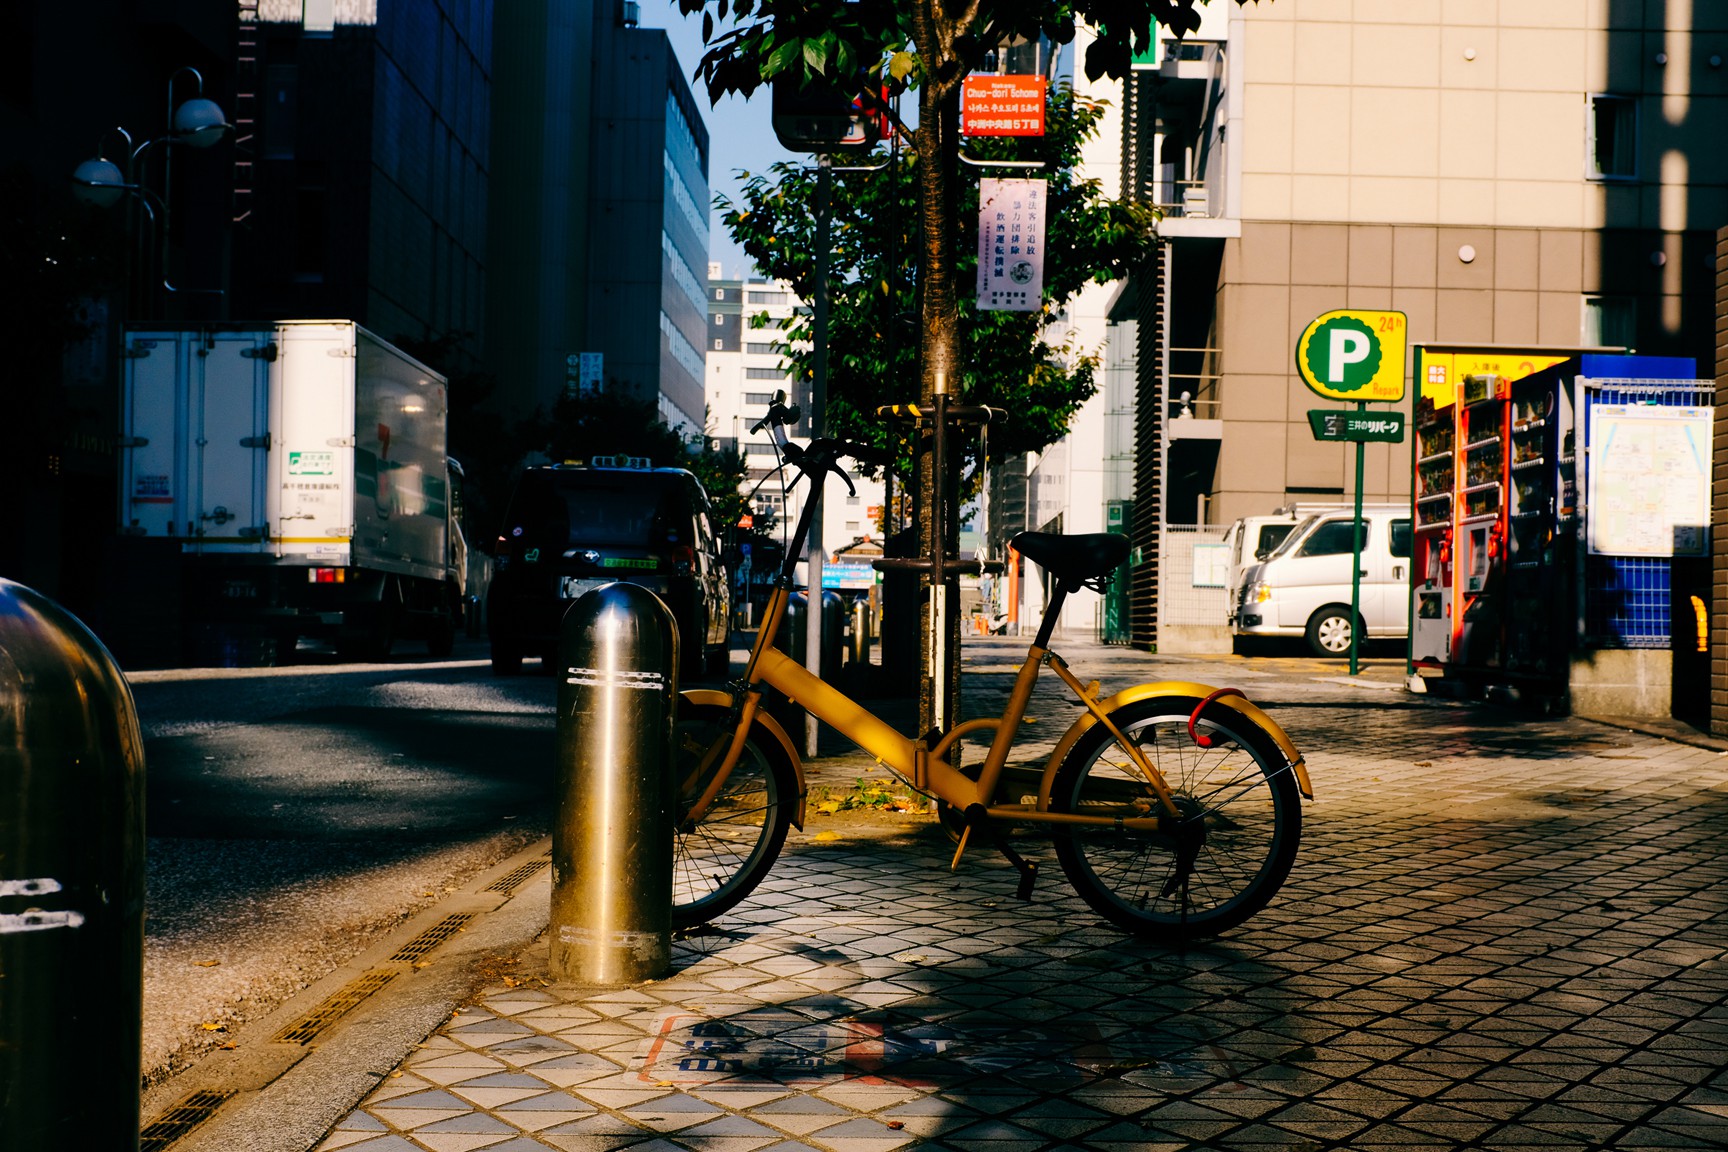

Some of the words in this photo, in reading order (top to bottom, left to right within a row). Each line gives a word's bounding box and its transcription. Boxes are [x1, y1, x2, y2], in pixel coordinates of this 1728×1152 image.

[967, 88, 1008, 98] Chuo-dori
[994, 211, 1006, 278] 飲酒運転撲滅
[1010, 200, 1022, 255] 暴力団排除
[1026, 189, 1038, 255] 違法客引追放
[1328, 328, 1371, 382] P
[1372, 382, 1400, 396] Repark
[1347, 419, 1399, 434] 三井のリパーク
